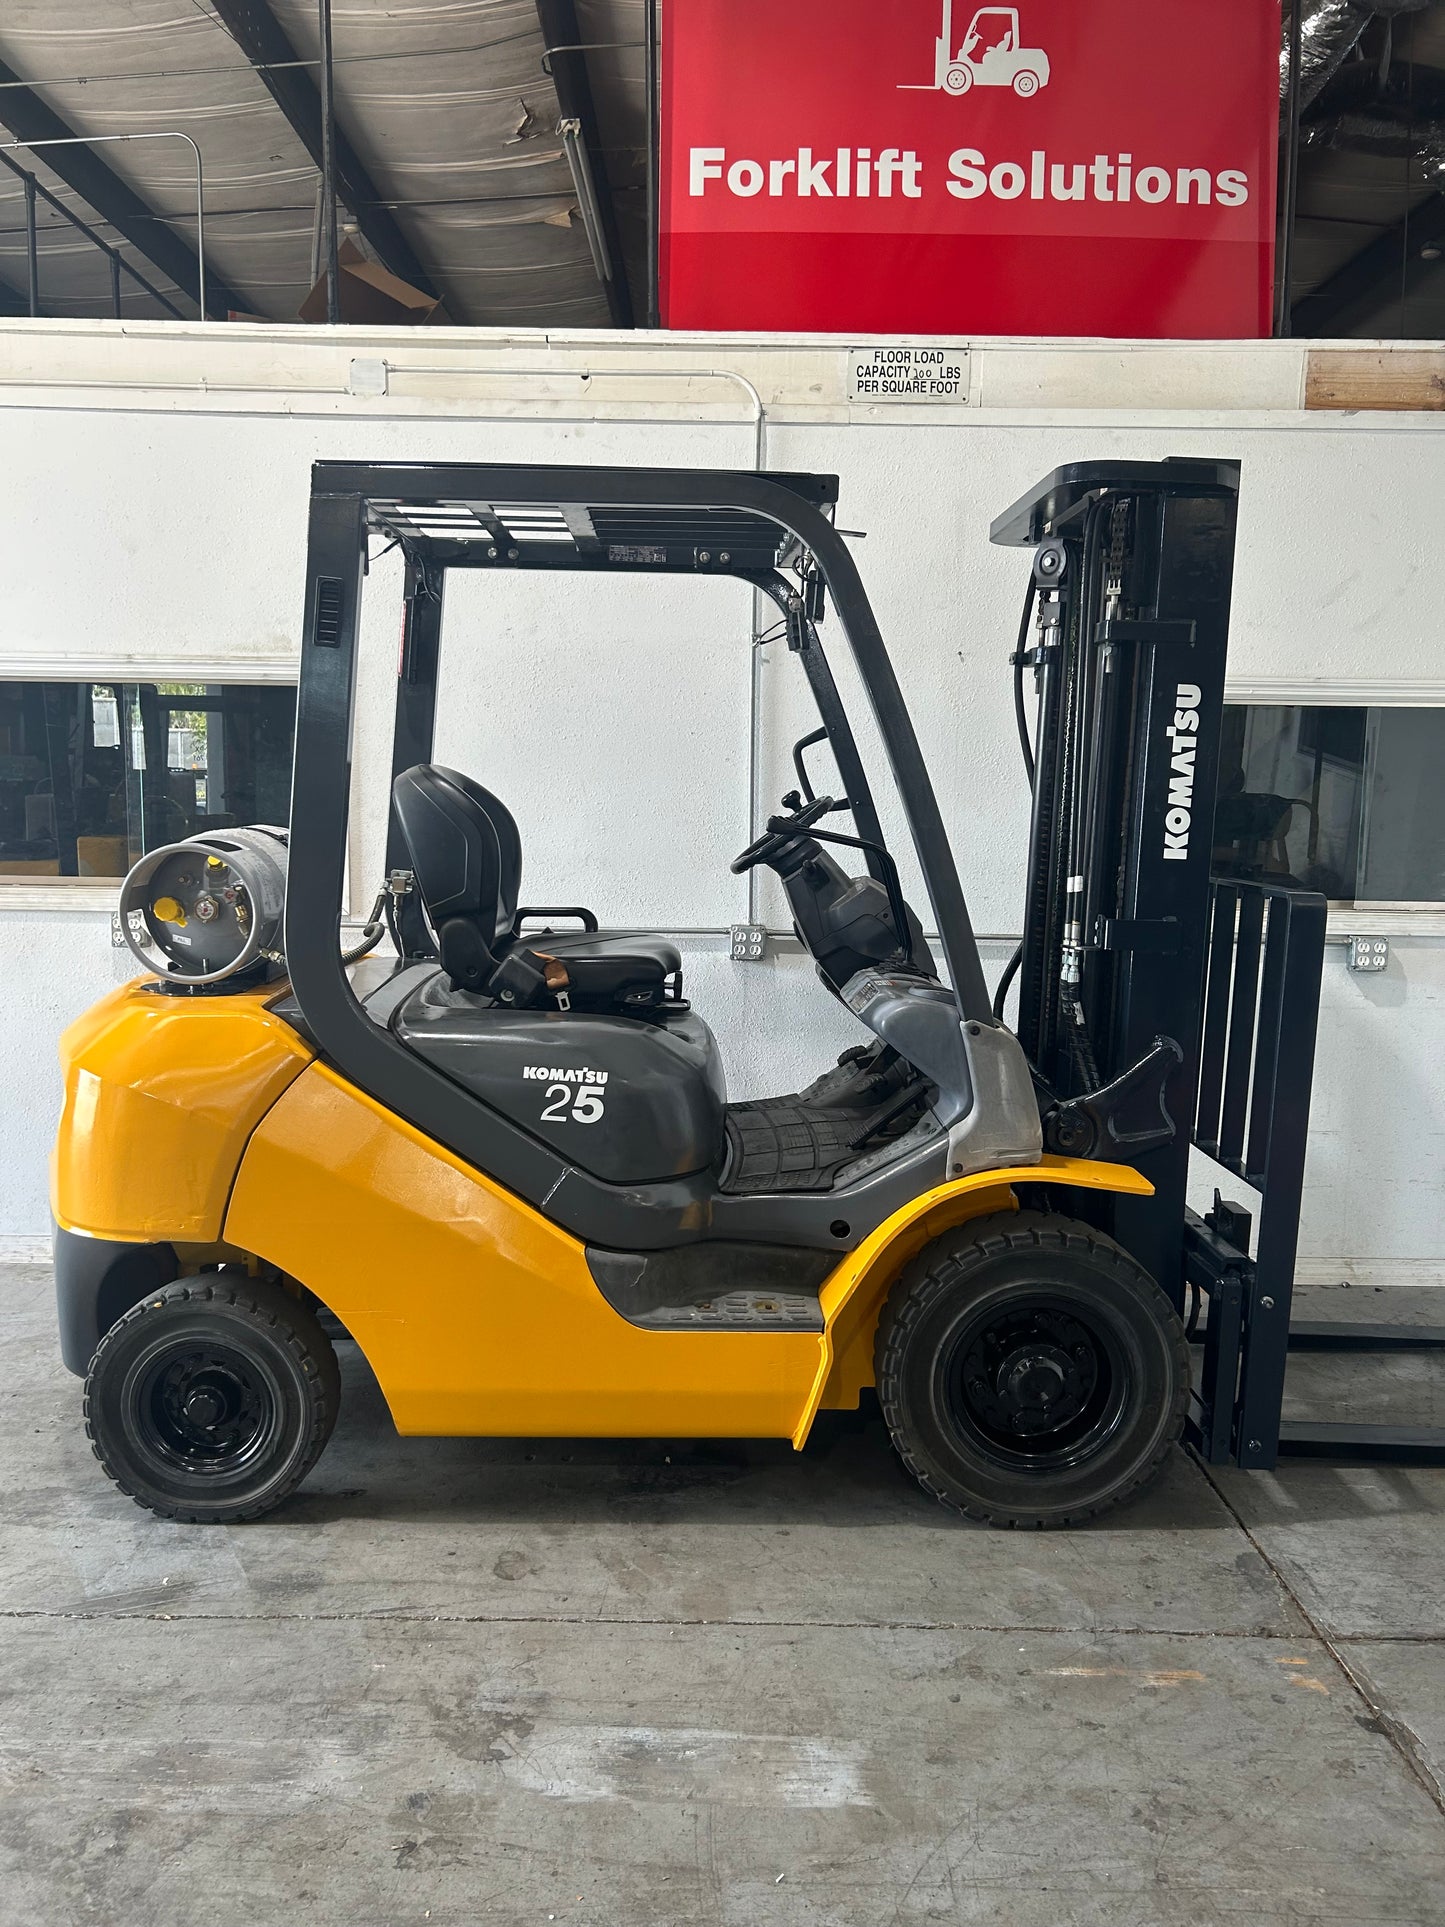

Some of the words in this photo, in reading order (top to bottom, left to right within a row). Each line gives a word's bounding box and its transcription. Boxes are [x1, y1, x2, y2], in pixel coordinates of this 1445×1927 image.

[689, 147, 922, 198] Forklift
[945, 148, 1249, 207] Solutions
[874, 351, 911, 363] FLOOR
[914, 351, 944, 364] LOAD
[856, 365, 910, 378] CAPACITY
[940, 366, 961, 379] LBS
[857, 380, 879, 392] PER
[881, 380, 927, 393] SQUARE
[929, 381, 960, 394] FOOT
[1163, 683, 1202, 860] KOMATSU
[523, 1066, 609, 1084] KOMATSU
[540, 1083, 605, 1124] 25
